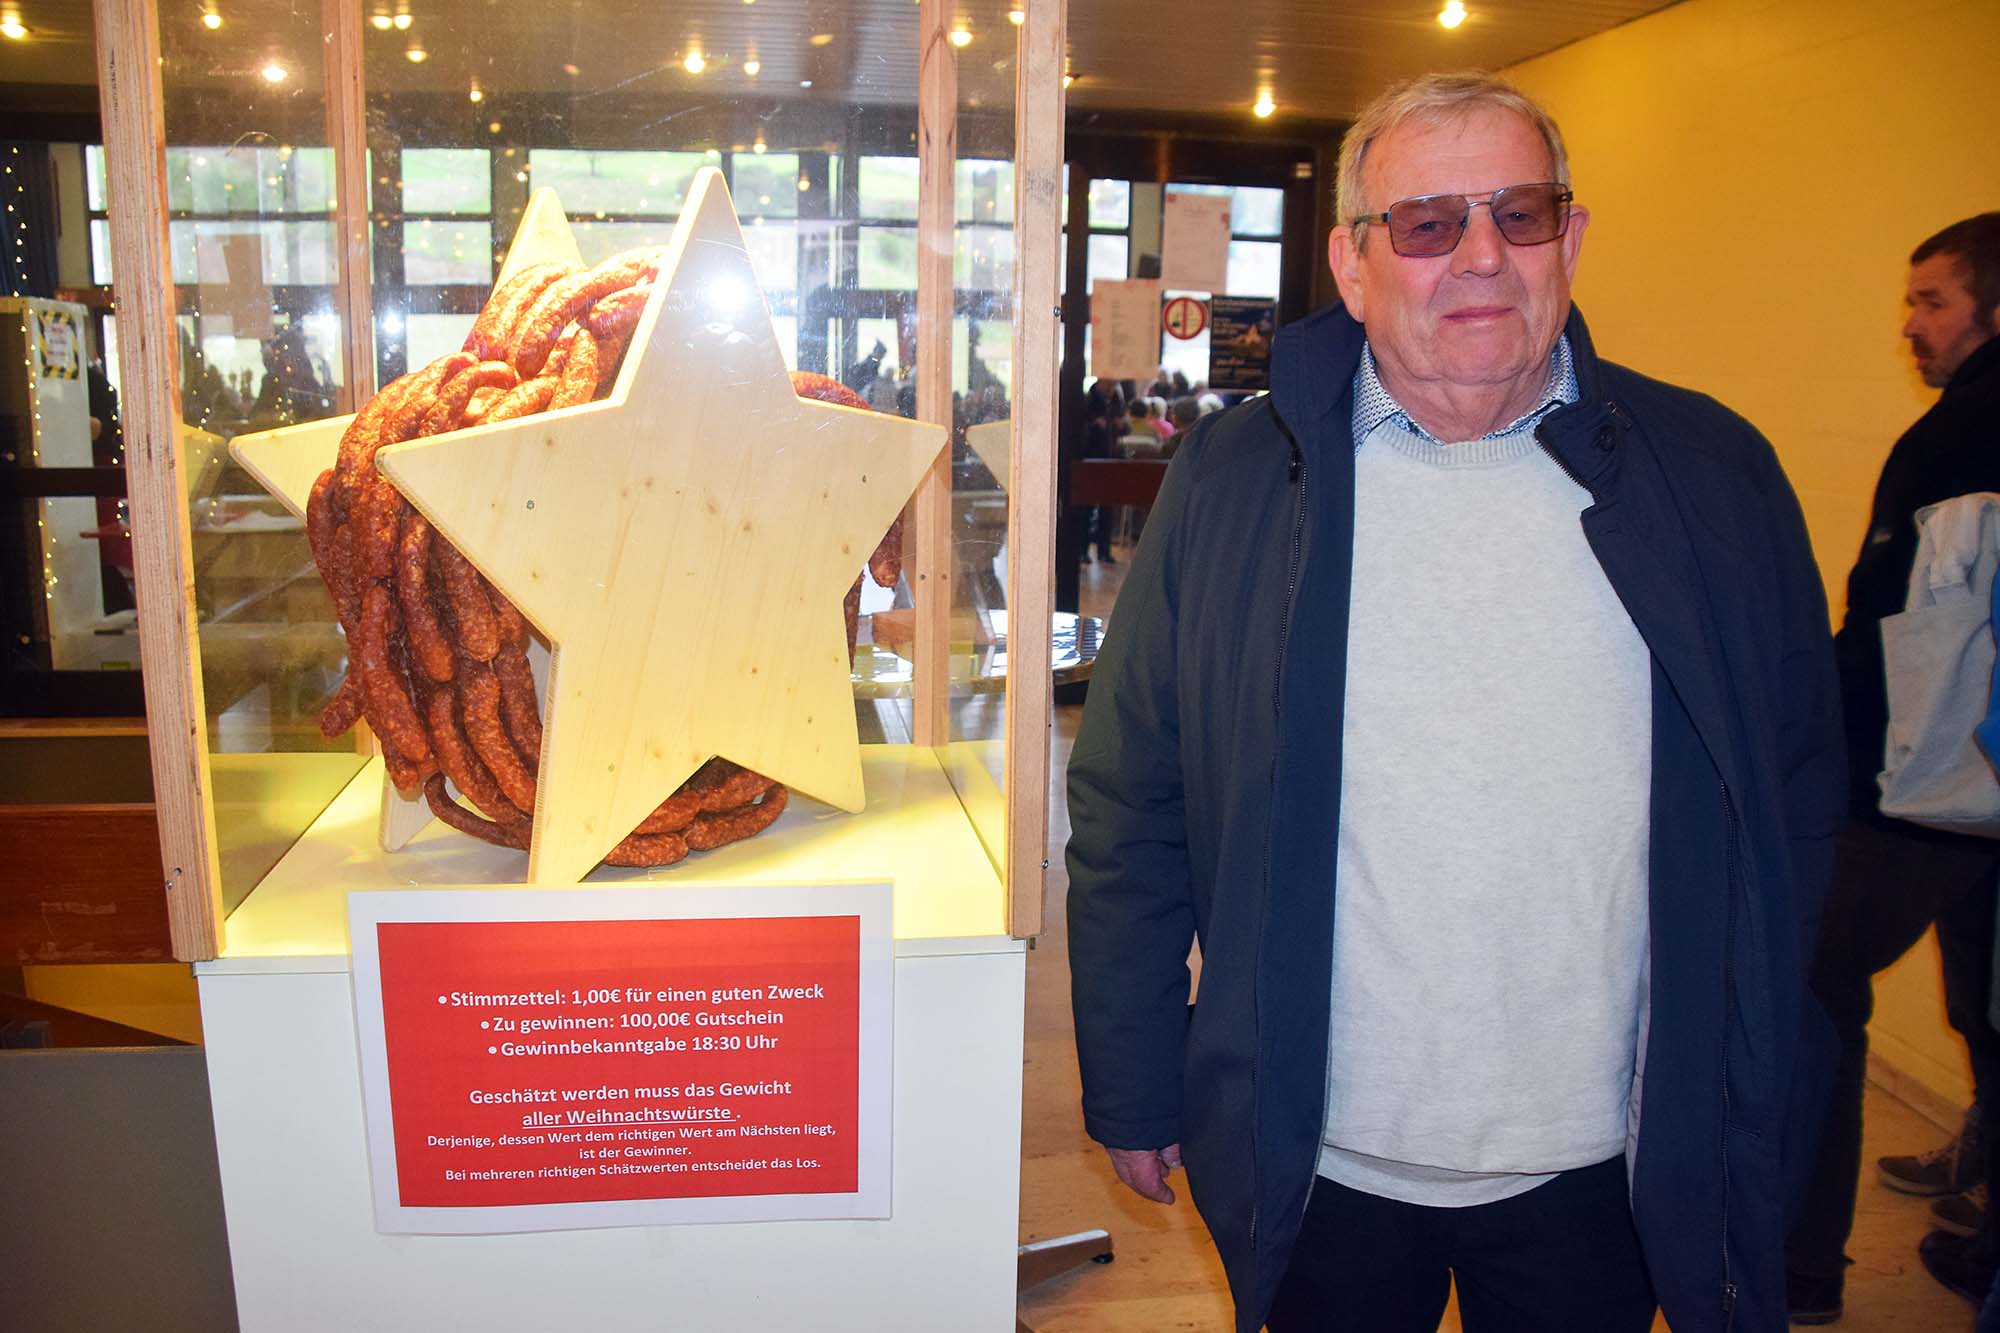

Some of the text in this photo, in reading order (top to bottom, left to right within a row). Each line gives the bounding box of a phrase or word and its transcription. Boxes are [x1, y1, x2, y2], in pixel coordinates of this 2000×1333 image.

[450, 983, 825, 1007] Stimmzettel: 1,00€ für einen guten Zweck
[492, 1009, 784, 1034] Zu gewinnen: 100,00€ Gutschein
[500, 1034, 779, 1057] Gewinnbekanntgabe 18:30 Uhr
[469, 1081, 791, 1104] Geschätzt werden muss das Gewicht
[522, 1111, 561, 1127] aller
[566, 1106, 731, 1124] Weihnachtswürste
[427, 1123, 836, 1149] Derjenige, dessen Wert dem richtigen Wert am Nächsten liegt,
[579, 1145, 692, 1160] ist der Gewinner.
[445, 1157, 821, 1181] Bei mehreren richtigen Schätzwerten entscheidet das Los.
